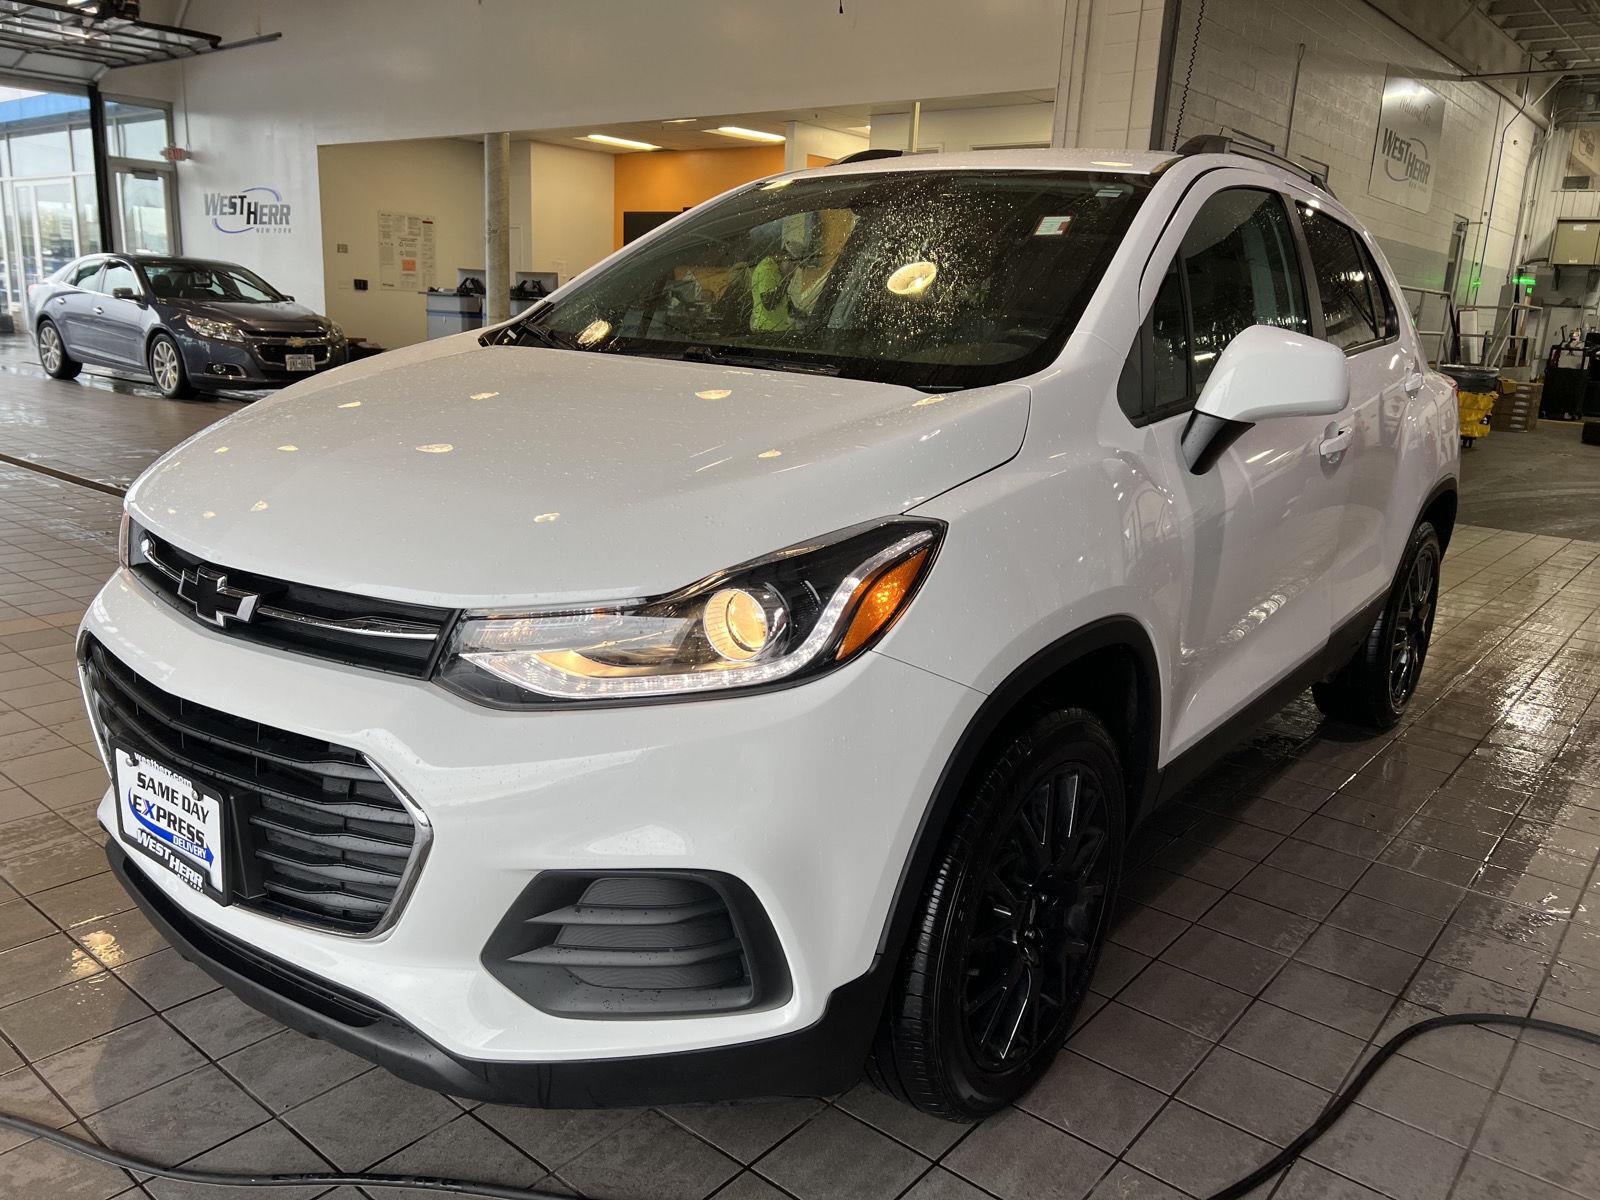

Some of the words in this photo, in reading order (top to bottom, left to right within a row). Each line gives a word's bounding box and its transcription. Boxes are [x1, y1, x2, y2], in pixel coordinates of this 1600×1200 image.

[1382, 127, 1411, 164] WEST
[1405, 151, 1431, 185] HERR
[204, 193, 247, 216] WEST
[246, 201, 291, 225] HERR
[133, 793, 208, 848] EXPRESS
[136, 771, 179, 807] SAME
[182, 793, 210, 825] DAY
[136, 829, 172, 860] WEST
[169, 856, 204, 887] HERR
[172, 836, 208, 860] DELIVERY
